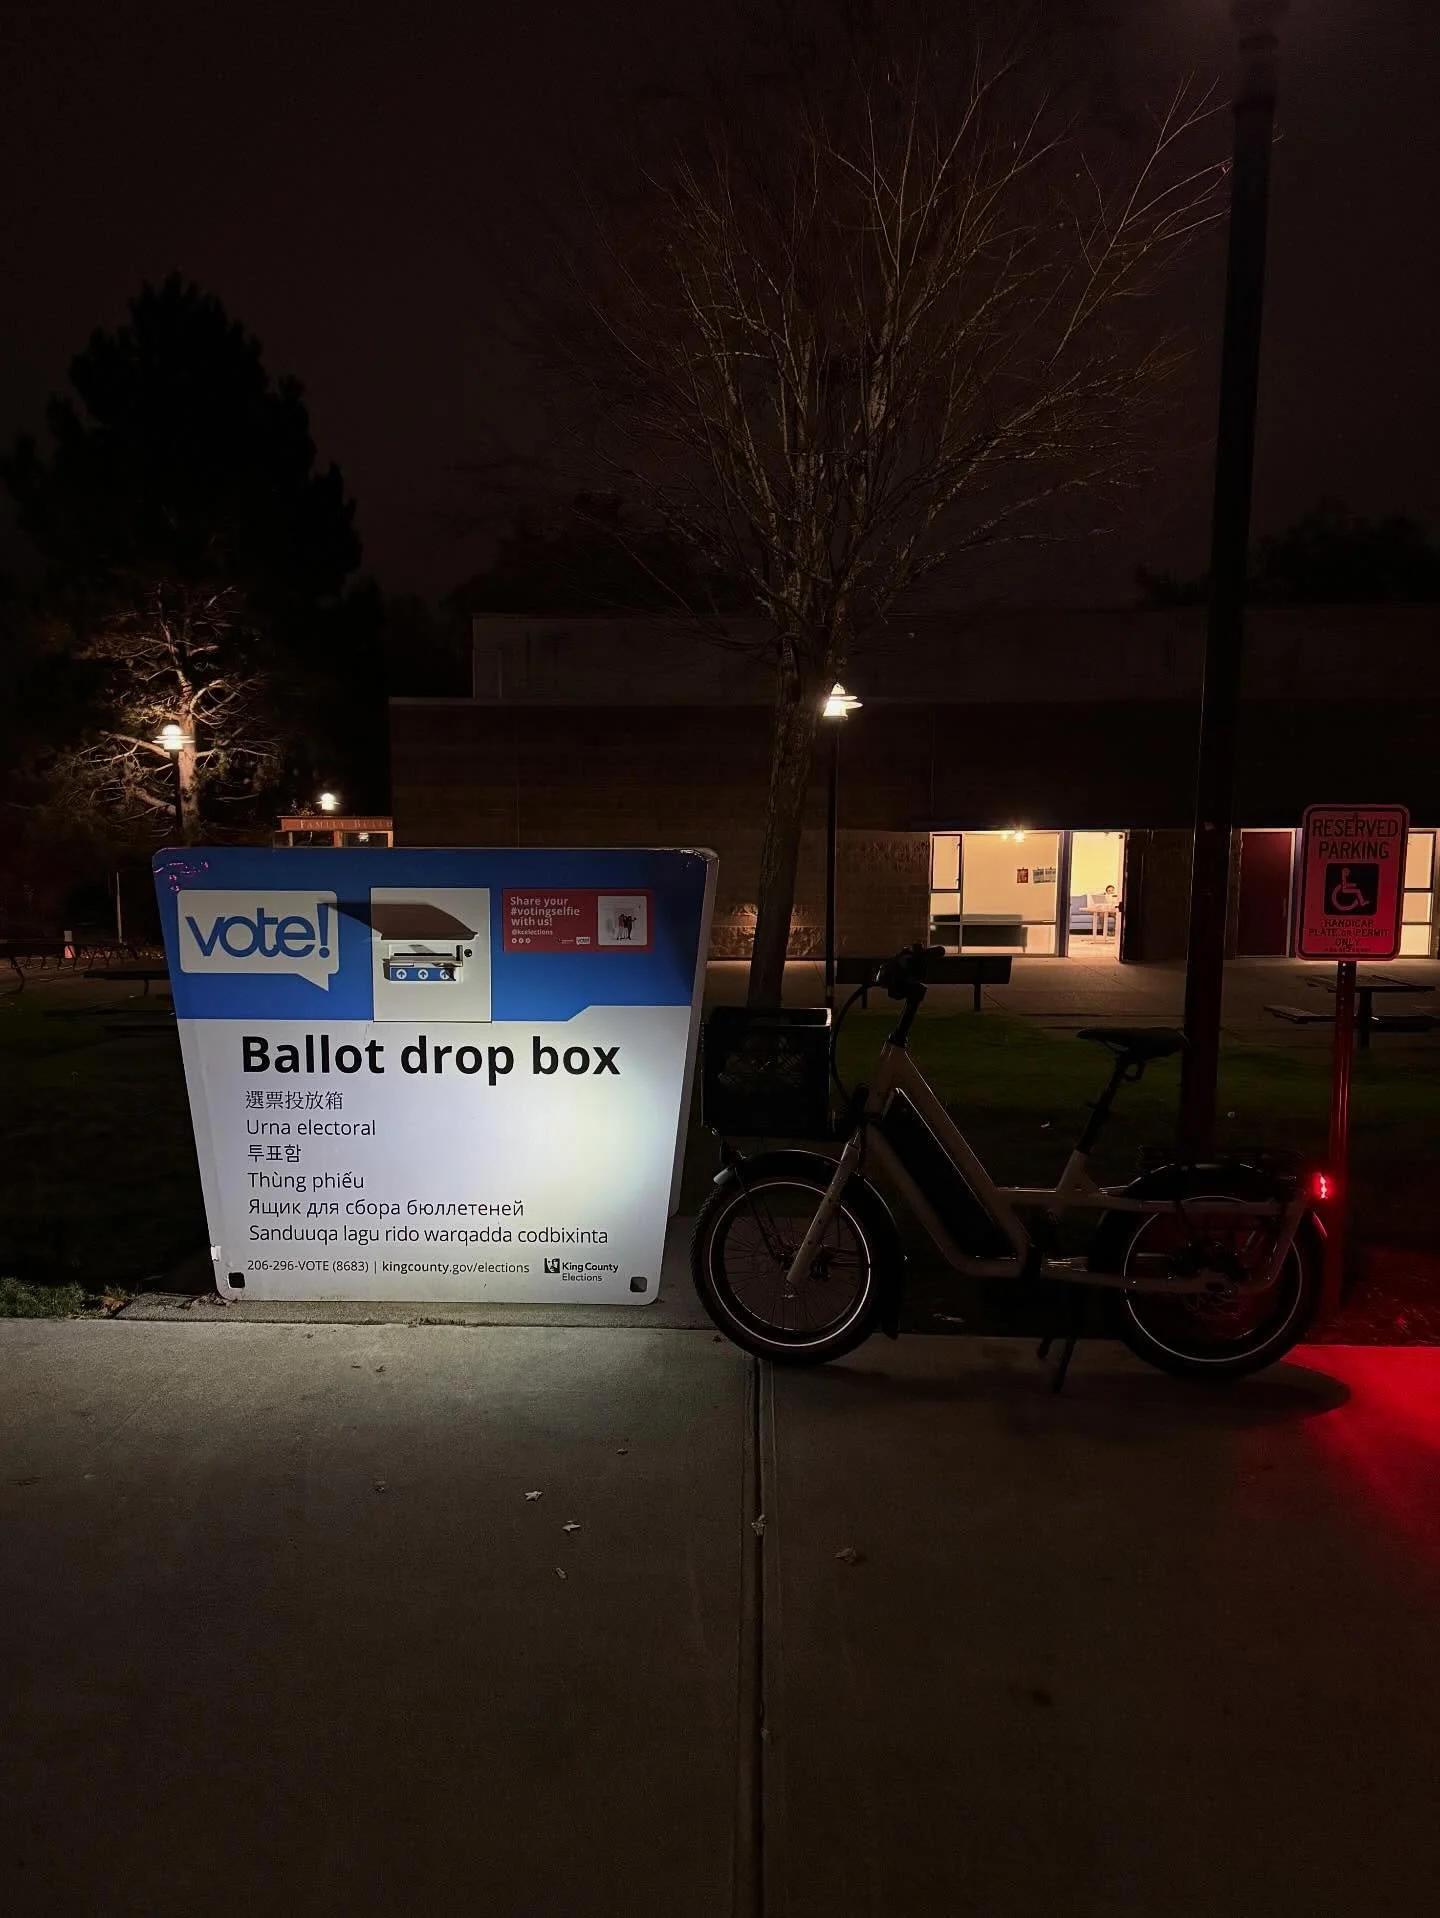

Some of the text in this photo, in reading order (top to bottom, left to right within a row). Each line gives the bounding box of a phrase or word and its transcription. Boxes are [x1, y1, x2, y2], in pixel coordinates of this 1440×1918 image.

[1312, 818, 1399, 837] RESERVED
[1319, 841, 1389, 860] PARKING
[510, 896, 568, 908] Share your
[511, 907, 580, 918] #votingselfie
[511, 916, 553, 926] with us!
[185, 903, 331, 958] vote!
[1324, 920, 1374, 928] HANDICAP
[1308, 929, 1337, 937] PLATE
[1355, 929, 1391, 938] PERMIT
[242, 1034, 621, 1086] Ballot drop box
[245, 1090, 343, 1111] 選票投放箱
[247, 1118, 376, 1136] Urna electoral
[247, 1144, 302, 1163] 투표함
[247, 1172, 364, 1193] Thùng phiếu
[249, 1199, 525, 1219] Ящик для сбора бюллетеней
[249, 1225, 609, 1247] Sanduuqa lagu rido warqadda codbixinta
[247, 1258, 530, 1275] 206-296-VOTE (8683) kingcounty.gov/elections
[562, 1261, 620, 1274] King County
[561, 1273, 604, 1283] Elections
